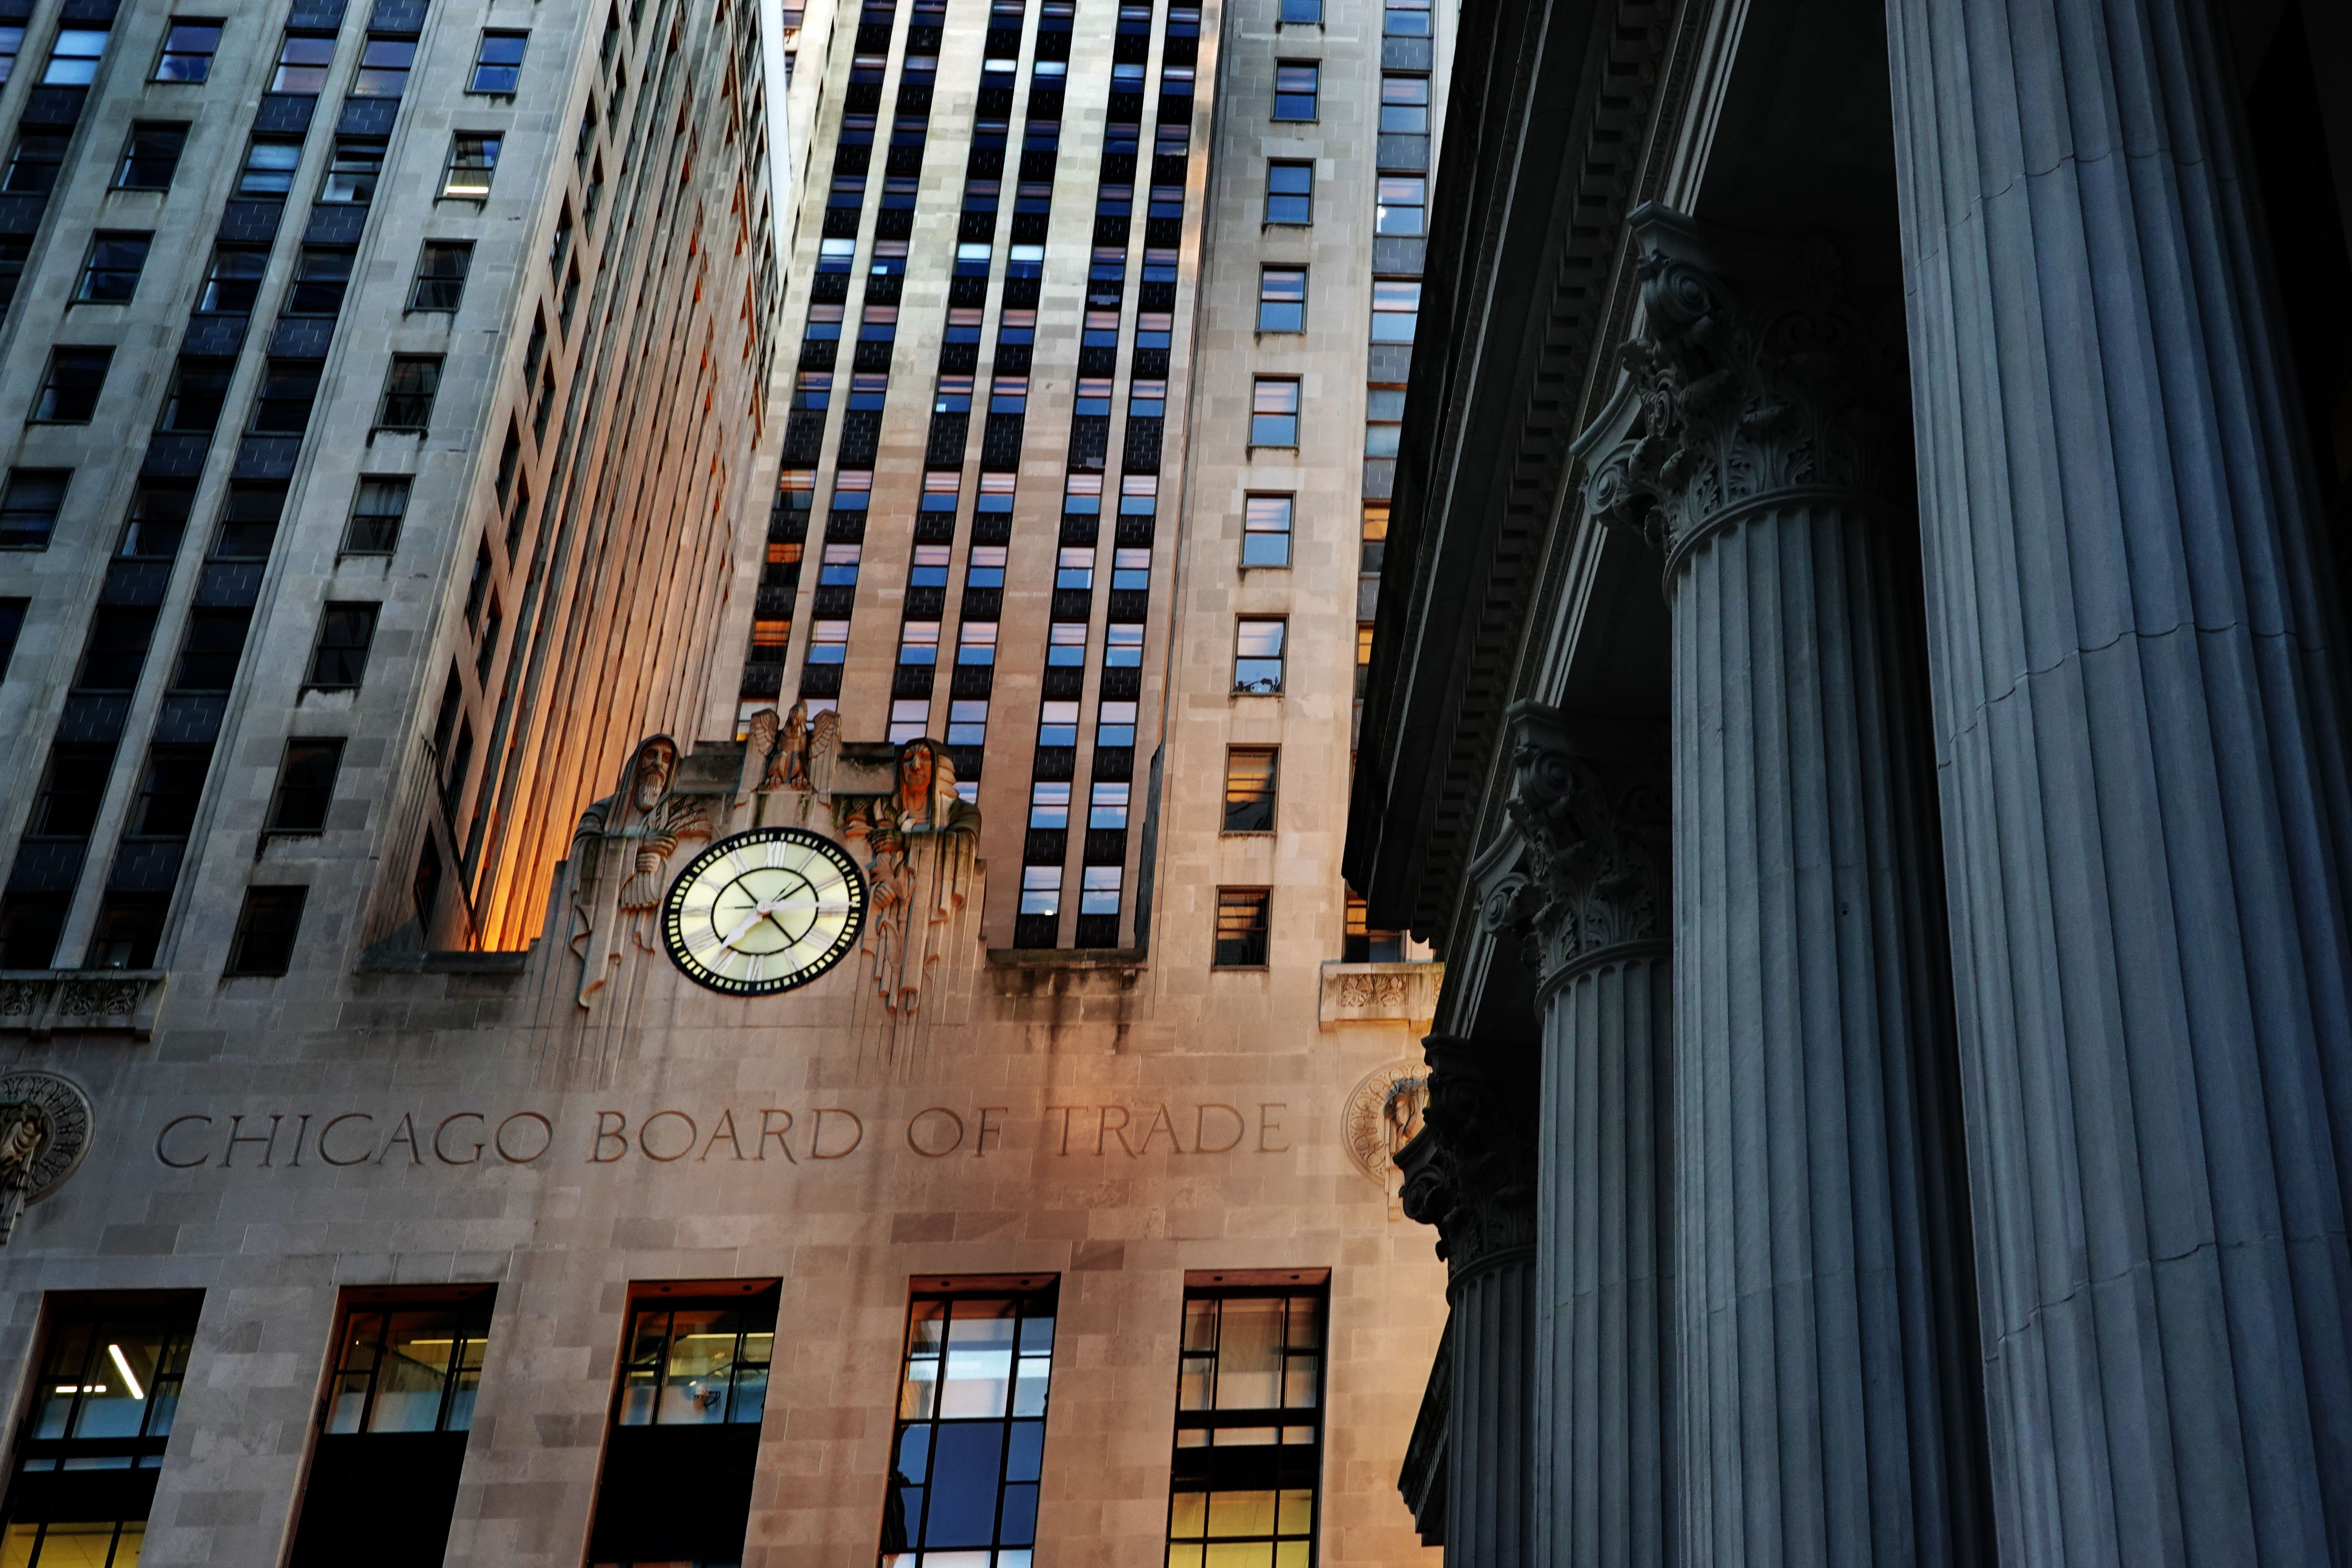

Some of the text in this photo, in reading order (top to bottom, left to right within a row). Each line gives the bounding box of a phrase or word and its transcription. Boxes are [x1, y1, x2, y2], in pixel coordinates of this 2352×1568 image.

[763, 841, 787, 868] XII
[153, 1102, 1290, 1169] CHICAGO BOARD OF TRADE
